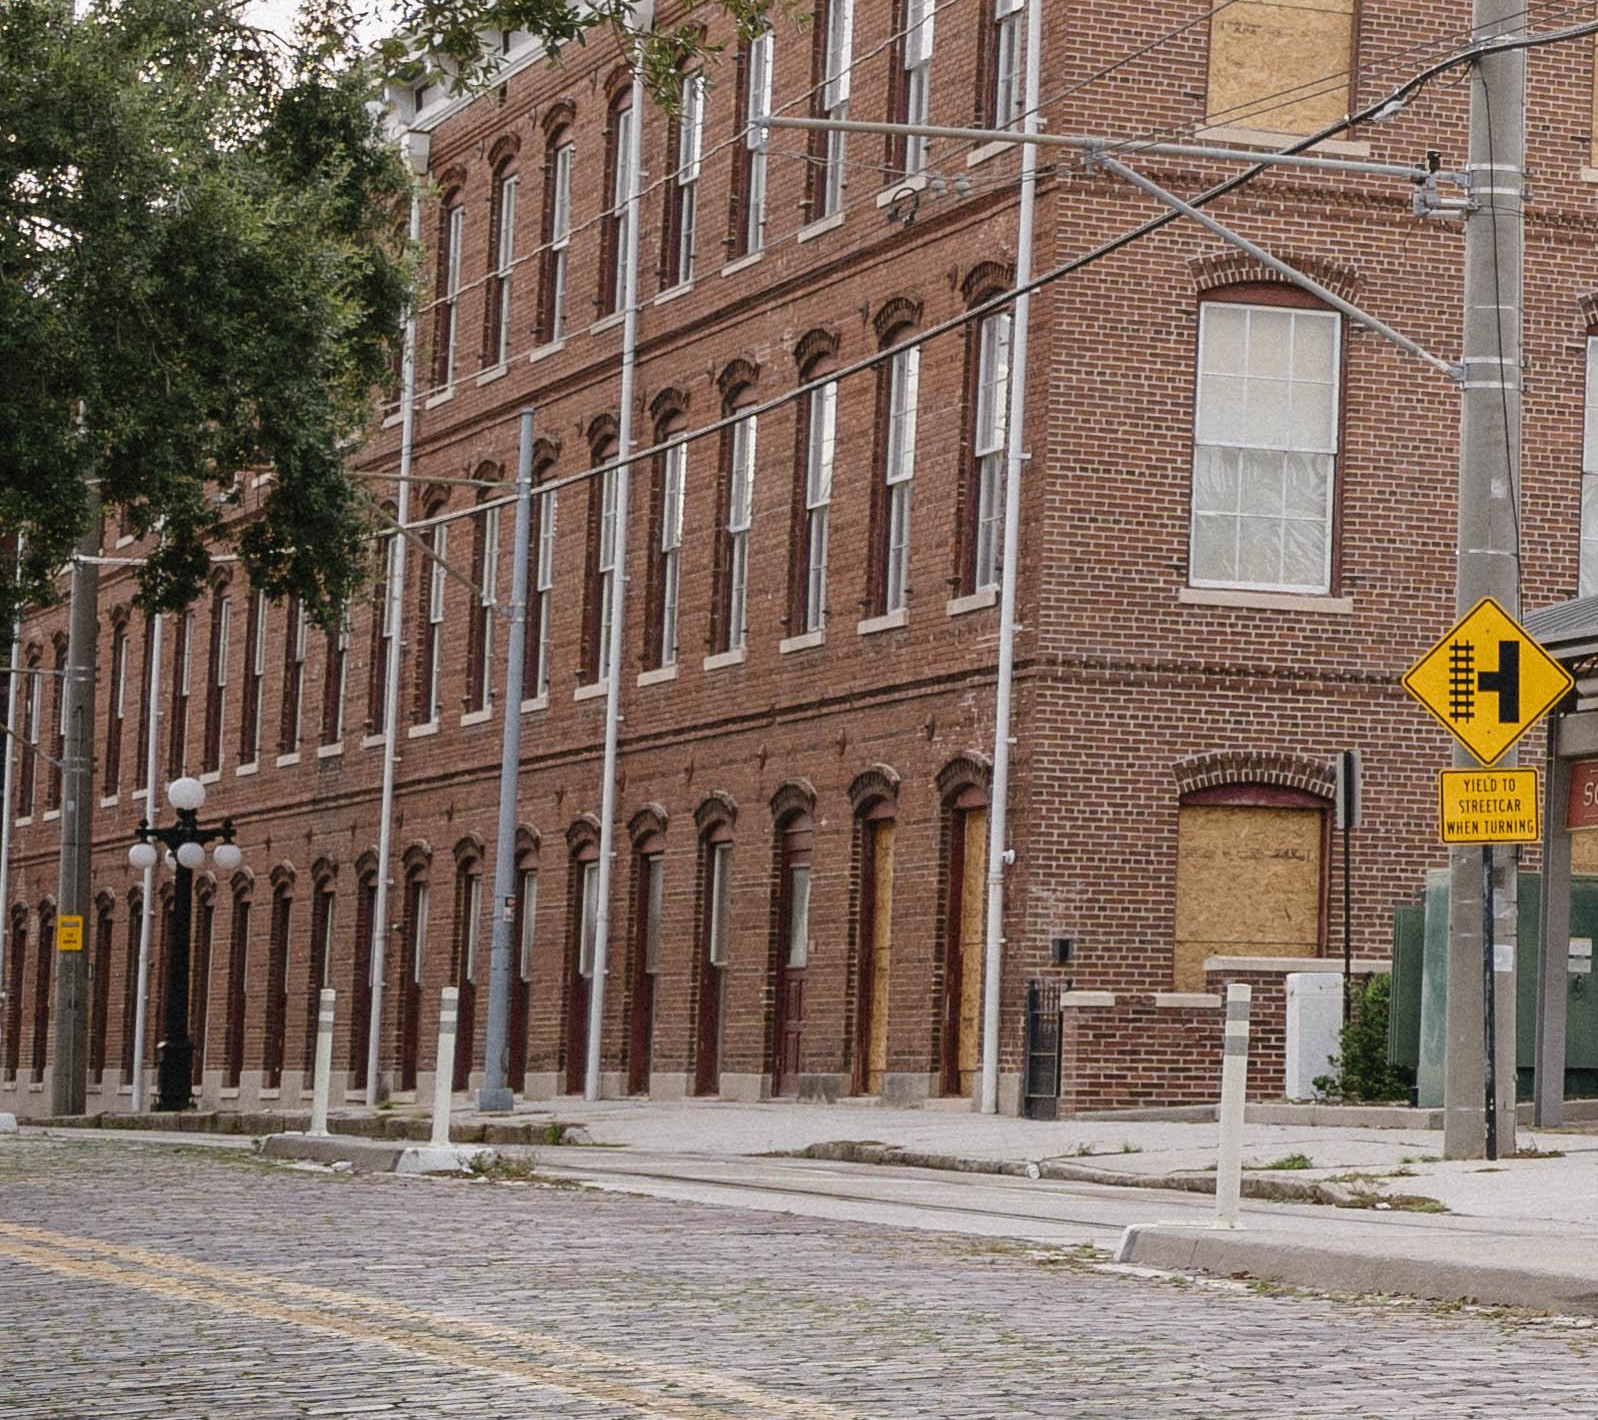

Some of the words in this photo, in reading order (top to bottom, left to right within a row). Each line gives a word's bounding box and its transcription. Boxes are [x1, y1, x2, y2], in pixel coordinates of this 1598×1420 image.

[1464, 778, 1497, 793] YIELD
[1503, 778, 1516, 792] TO
[1458, 799, 1521, 814] STREETCAR
[1446, 821, 1479, 835] WHEN
[1485, 819, 1534, 834] TURNING
